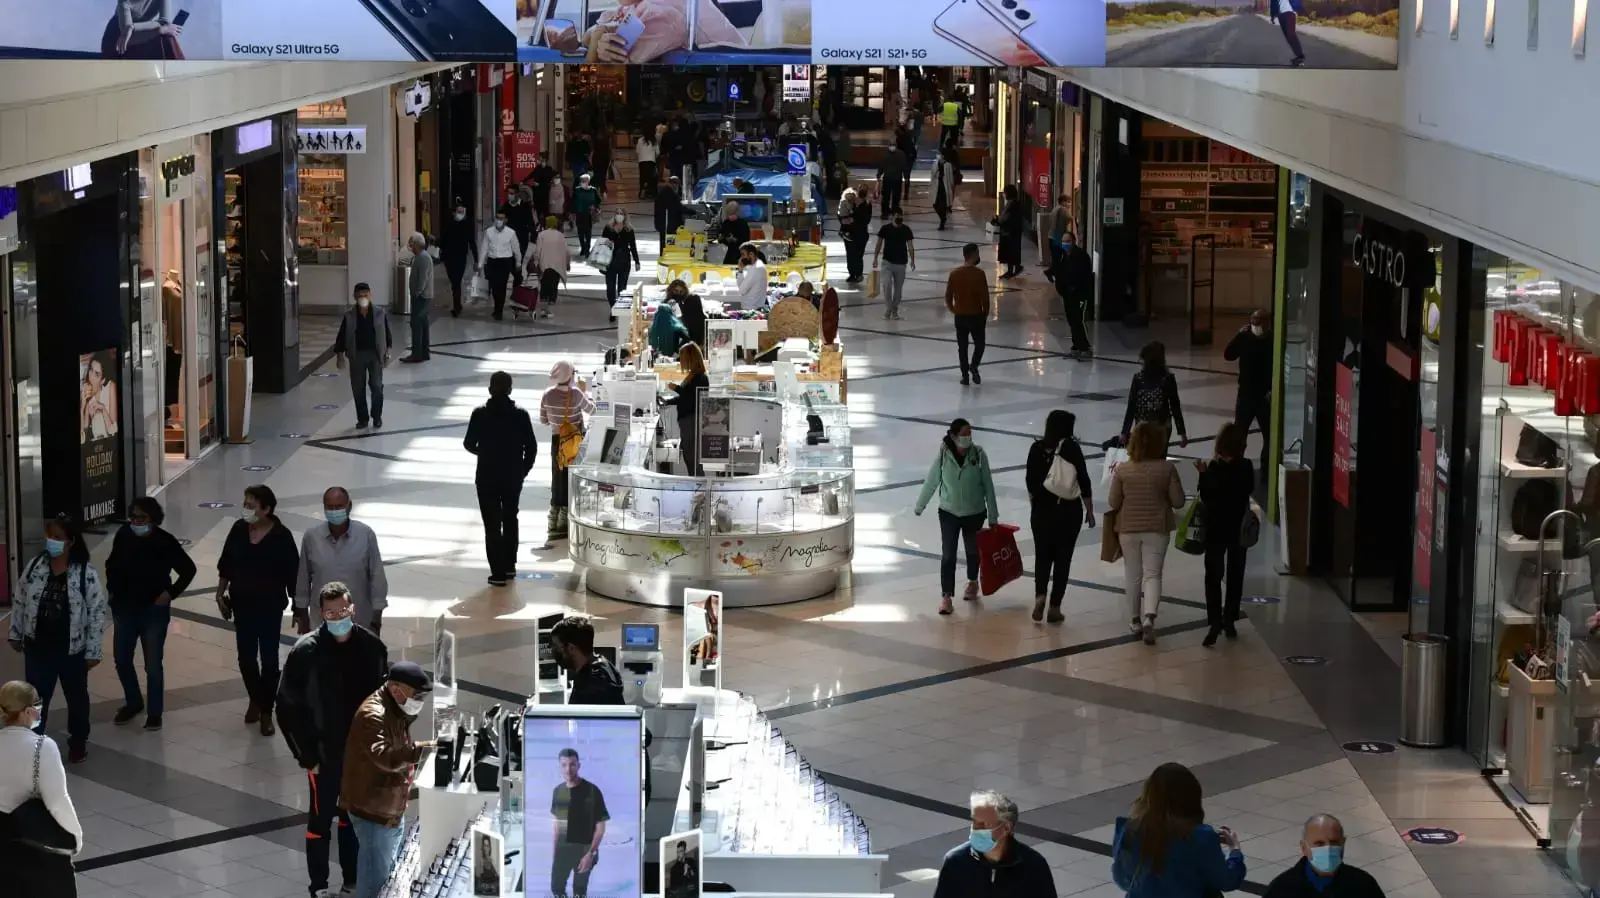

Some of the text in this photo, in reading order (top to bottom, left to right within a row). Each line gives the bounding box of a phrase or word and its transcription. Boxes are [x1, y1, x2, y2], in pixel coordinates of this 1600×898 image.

[231, 43, 340, 56] Galaxy S21 Ultra 5G
[821, 48, 928, 60] Galaxy S21 S21+ 5G
[516, 152, 536, 161] 50%
[516, 161, 536, 169] הנחה
[1352, 233, 1405, 288] CASTRO
[86, 451, 113, 468] HOLIDAY
[84, 506, 90, 521] IL
